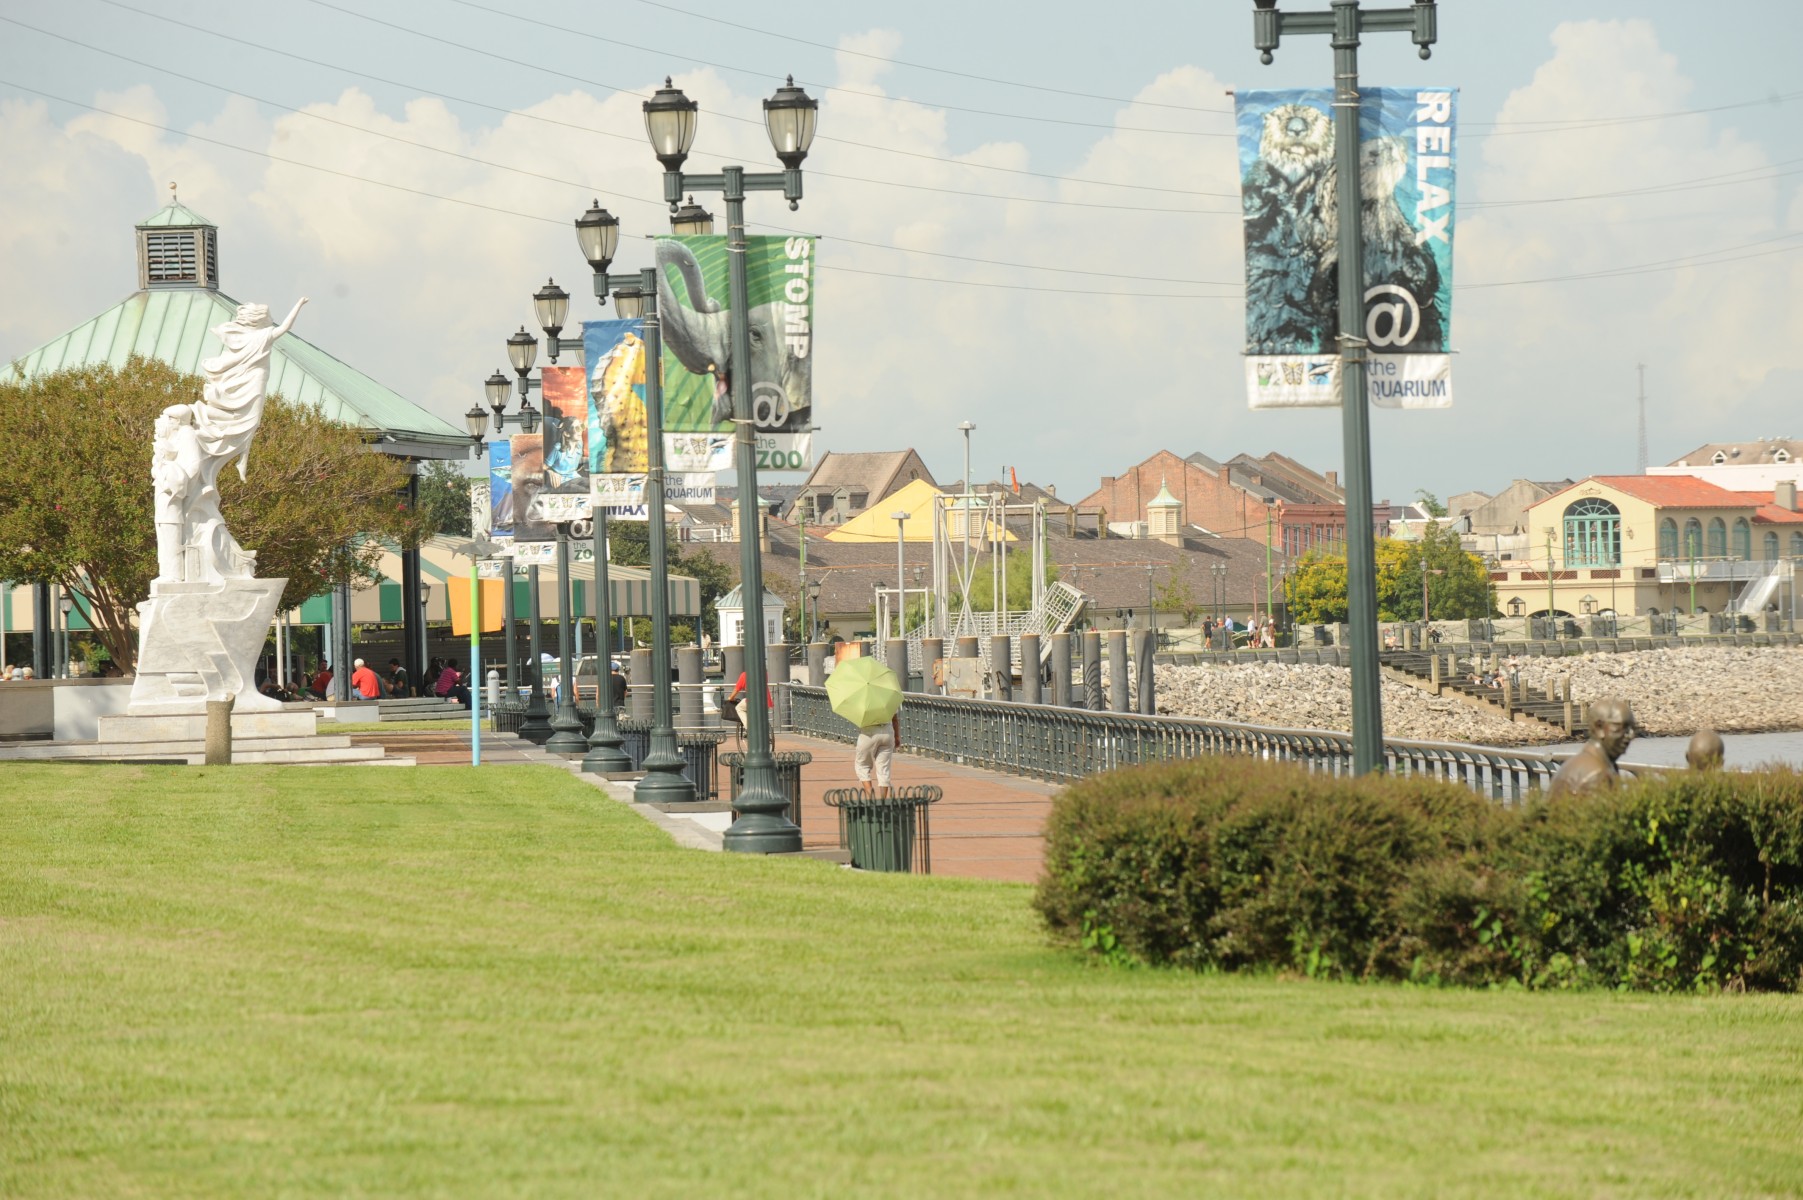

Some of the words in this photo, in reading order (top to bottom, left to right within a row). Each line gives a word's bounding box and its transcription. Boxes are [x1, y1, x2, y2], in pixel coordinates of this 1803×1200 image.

[1415, 92, 1451, 246] RELAX
[785, 237, 810, 359] STOMP
[1364, 284, 1421, 347] @
[1367, 358, 1396, 376] the
[1371, 379, 1446, 400] QUARIUM
[752, 381, 790, 428] @
[755, 436, 777, 449] the
[756, 450, 803, 469] ZOO
[665, 475, 683, 486] the
[665, 487, 712, 500] QUARIUM
[607, 505, 646, 516] MAX
[574, 549, 593, 560] ZO
[514, 566, 528, 575] ZO
